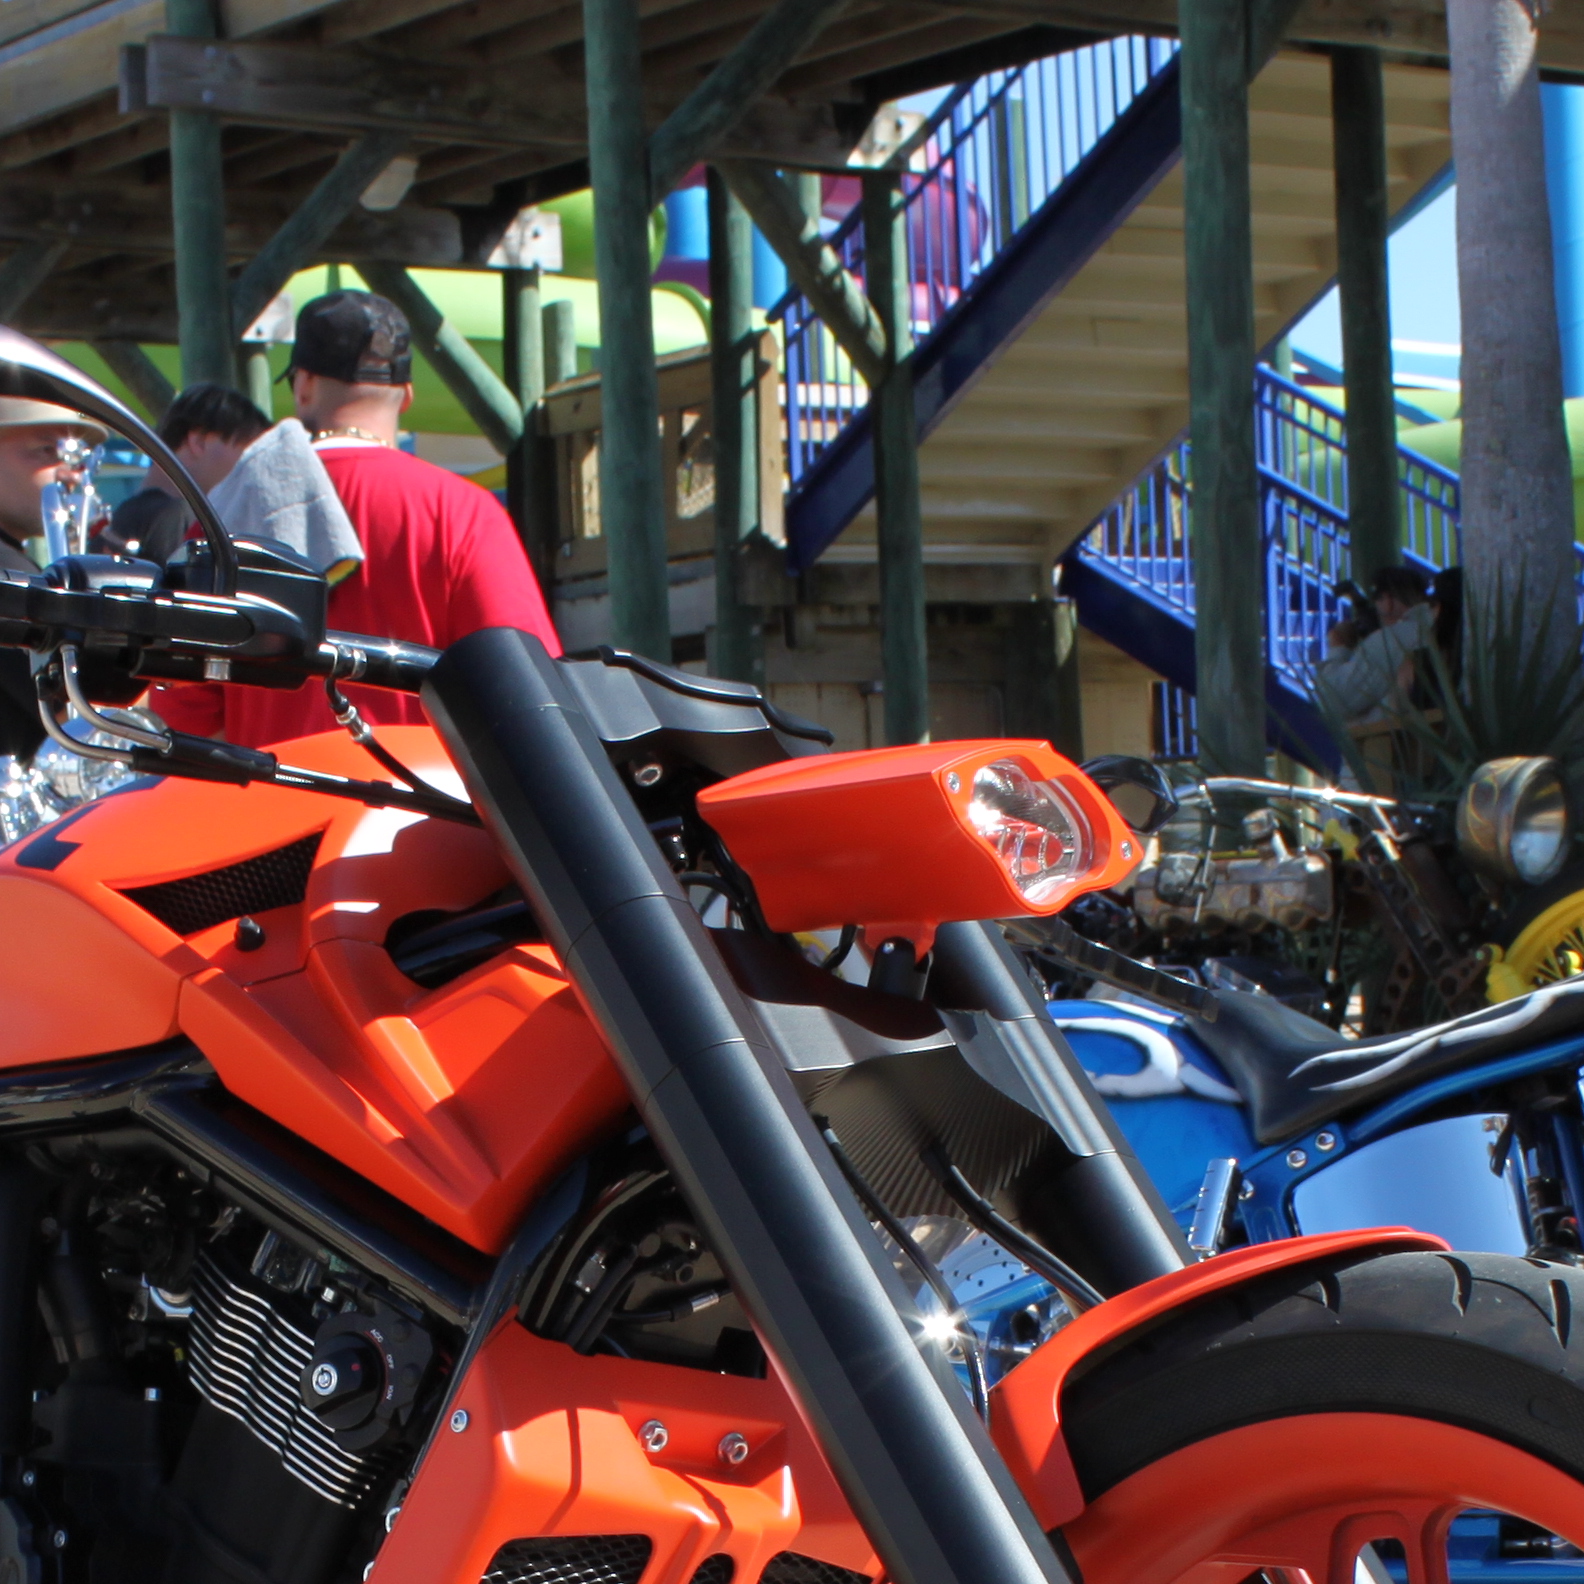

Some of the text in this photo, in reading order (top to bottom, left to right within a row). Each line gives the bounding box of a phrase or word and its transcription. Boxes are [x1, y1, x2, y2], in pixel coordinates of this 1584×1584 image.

[369, 1328, 384, 1343] ACC
[386, 1353, 395, 1370] OFF
[385, 1385, 395, 1401] IGN
